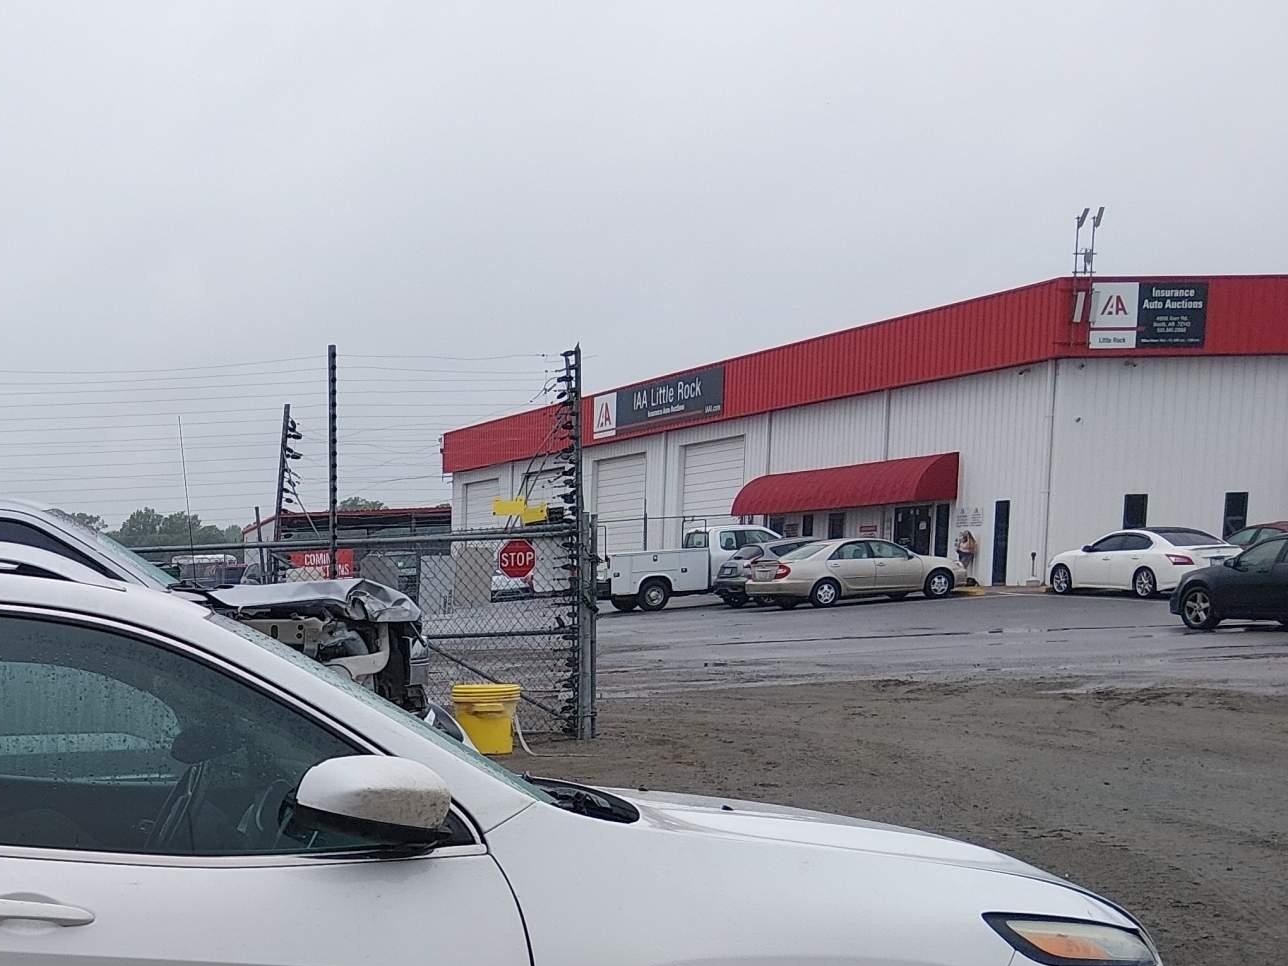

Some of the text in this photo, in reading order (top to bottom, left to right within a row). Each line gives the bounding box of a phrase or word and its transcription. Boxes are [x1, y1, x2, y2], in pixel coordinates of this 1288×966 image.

[1152, 287, 1195, 297] Insurance
[1143, 299, 1203, 309] Auto Auctions
[633, 376, 702, 410] IAA Little Rock
[304, 553, 330, 566] COMIN
[501, 552, 534, 566] STOP
